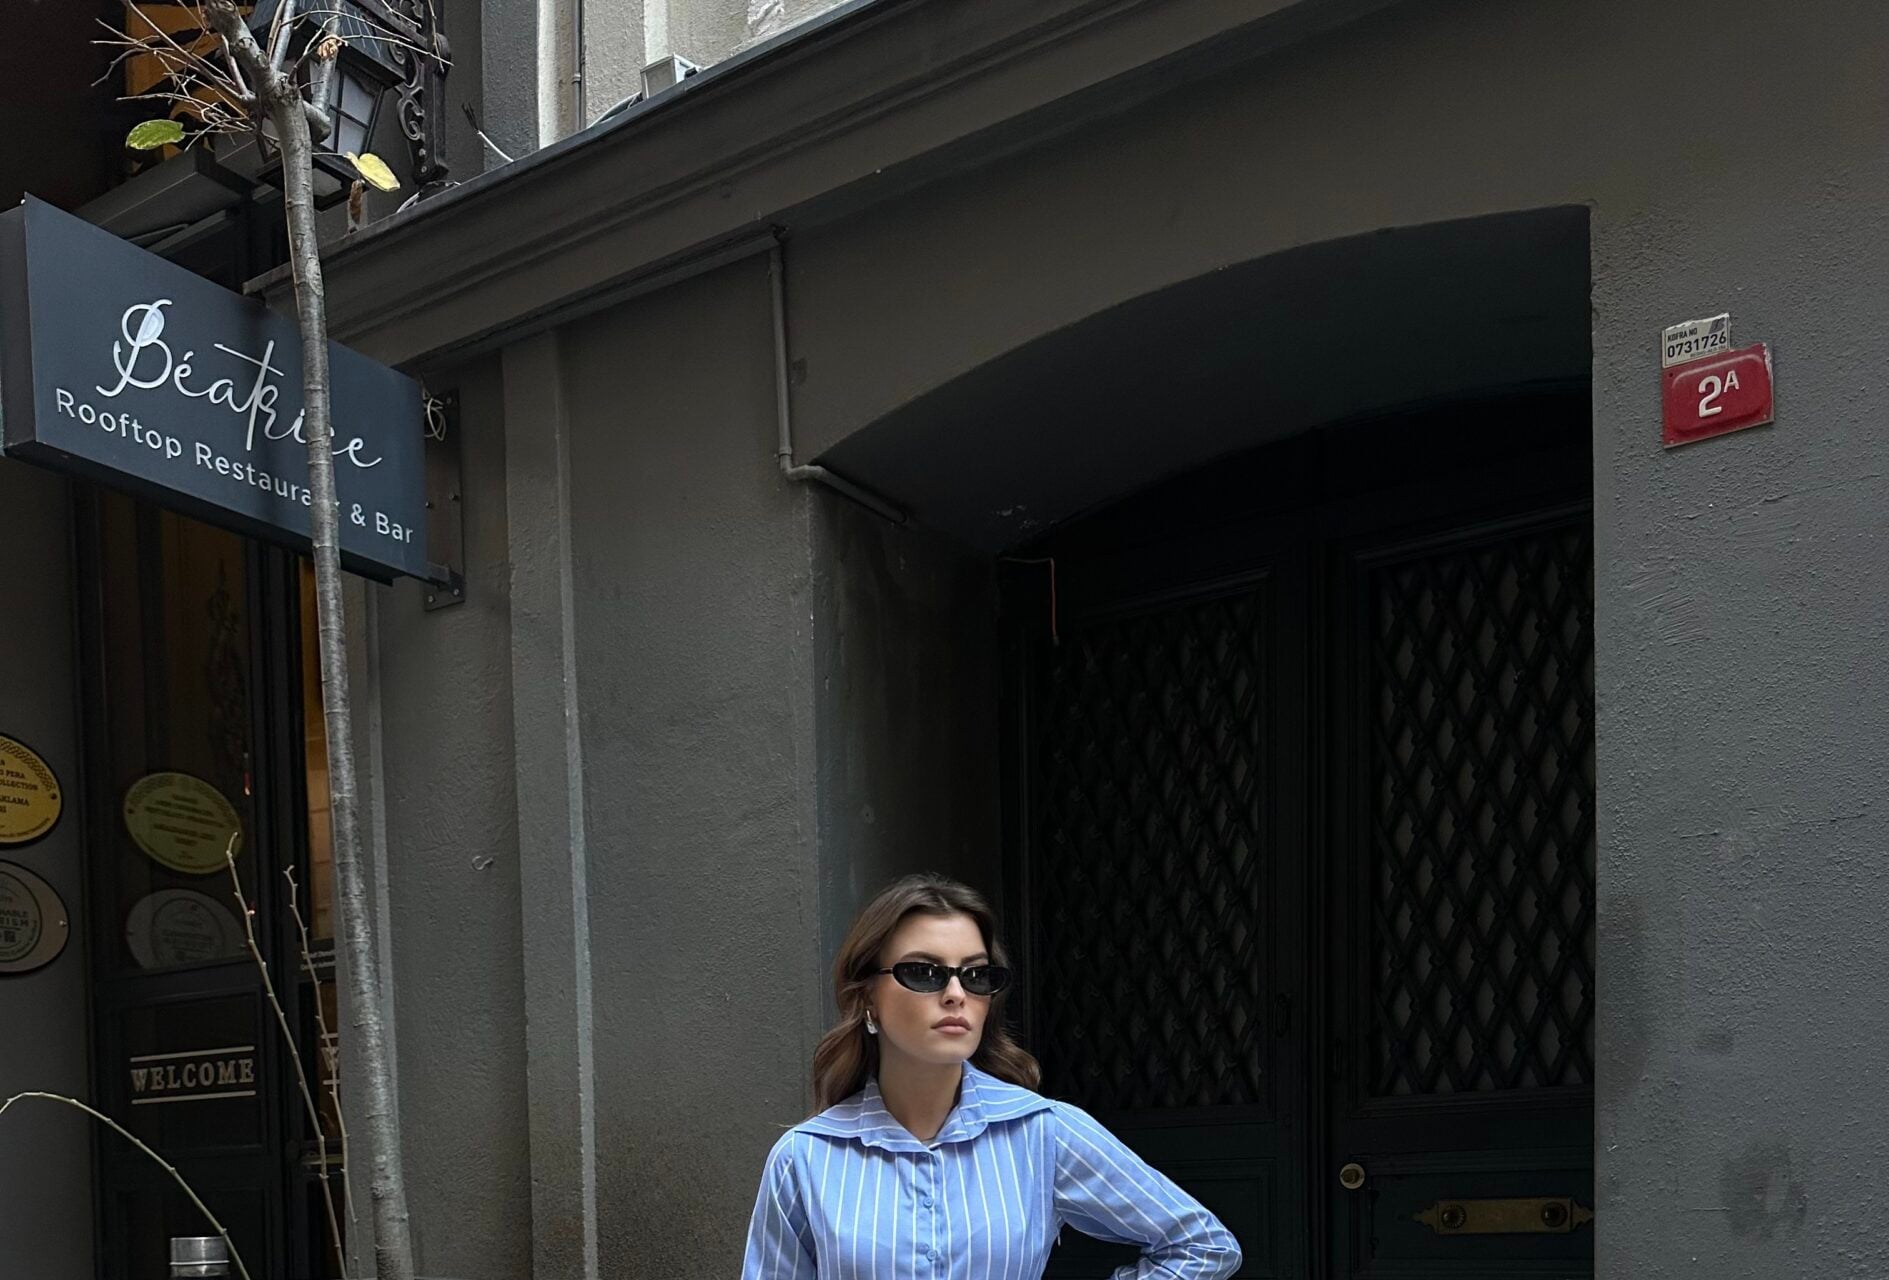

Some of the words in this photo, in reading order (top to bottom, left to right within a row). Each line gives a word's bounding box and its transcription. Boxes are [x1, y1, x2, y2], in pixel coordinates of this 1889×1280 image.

[96, 299, 382, 468] Béatrie
[1667, 331, 1727, 358] 0731726
[55, 388, 183, 459] Rooftop
[195, 442, 341, 508] Restaura
[350, 503, 367, 526] &
[375, 512, 414, 544] Bar
[130, 1058, 255, 1092] WELCOME
